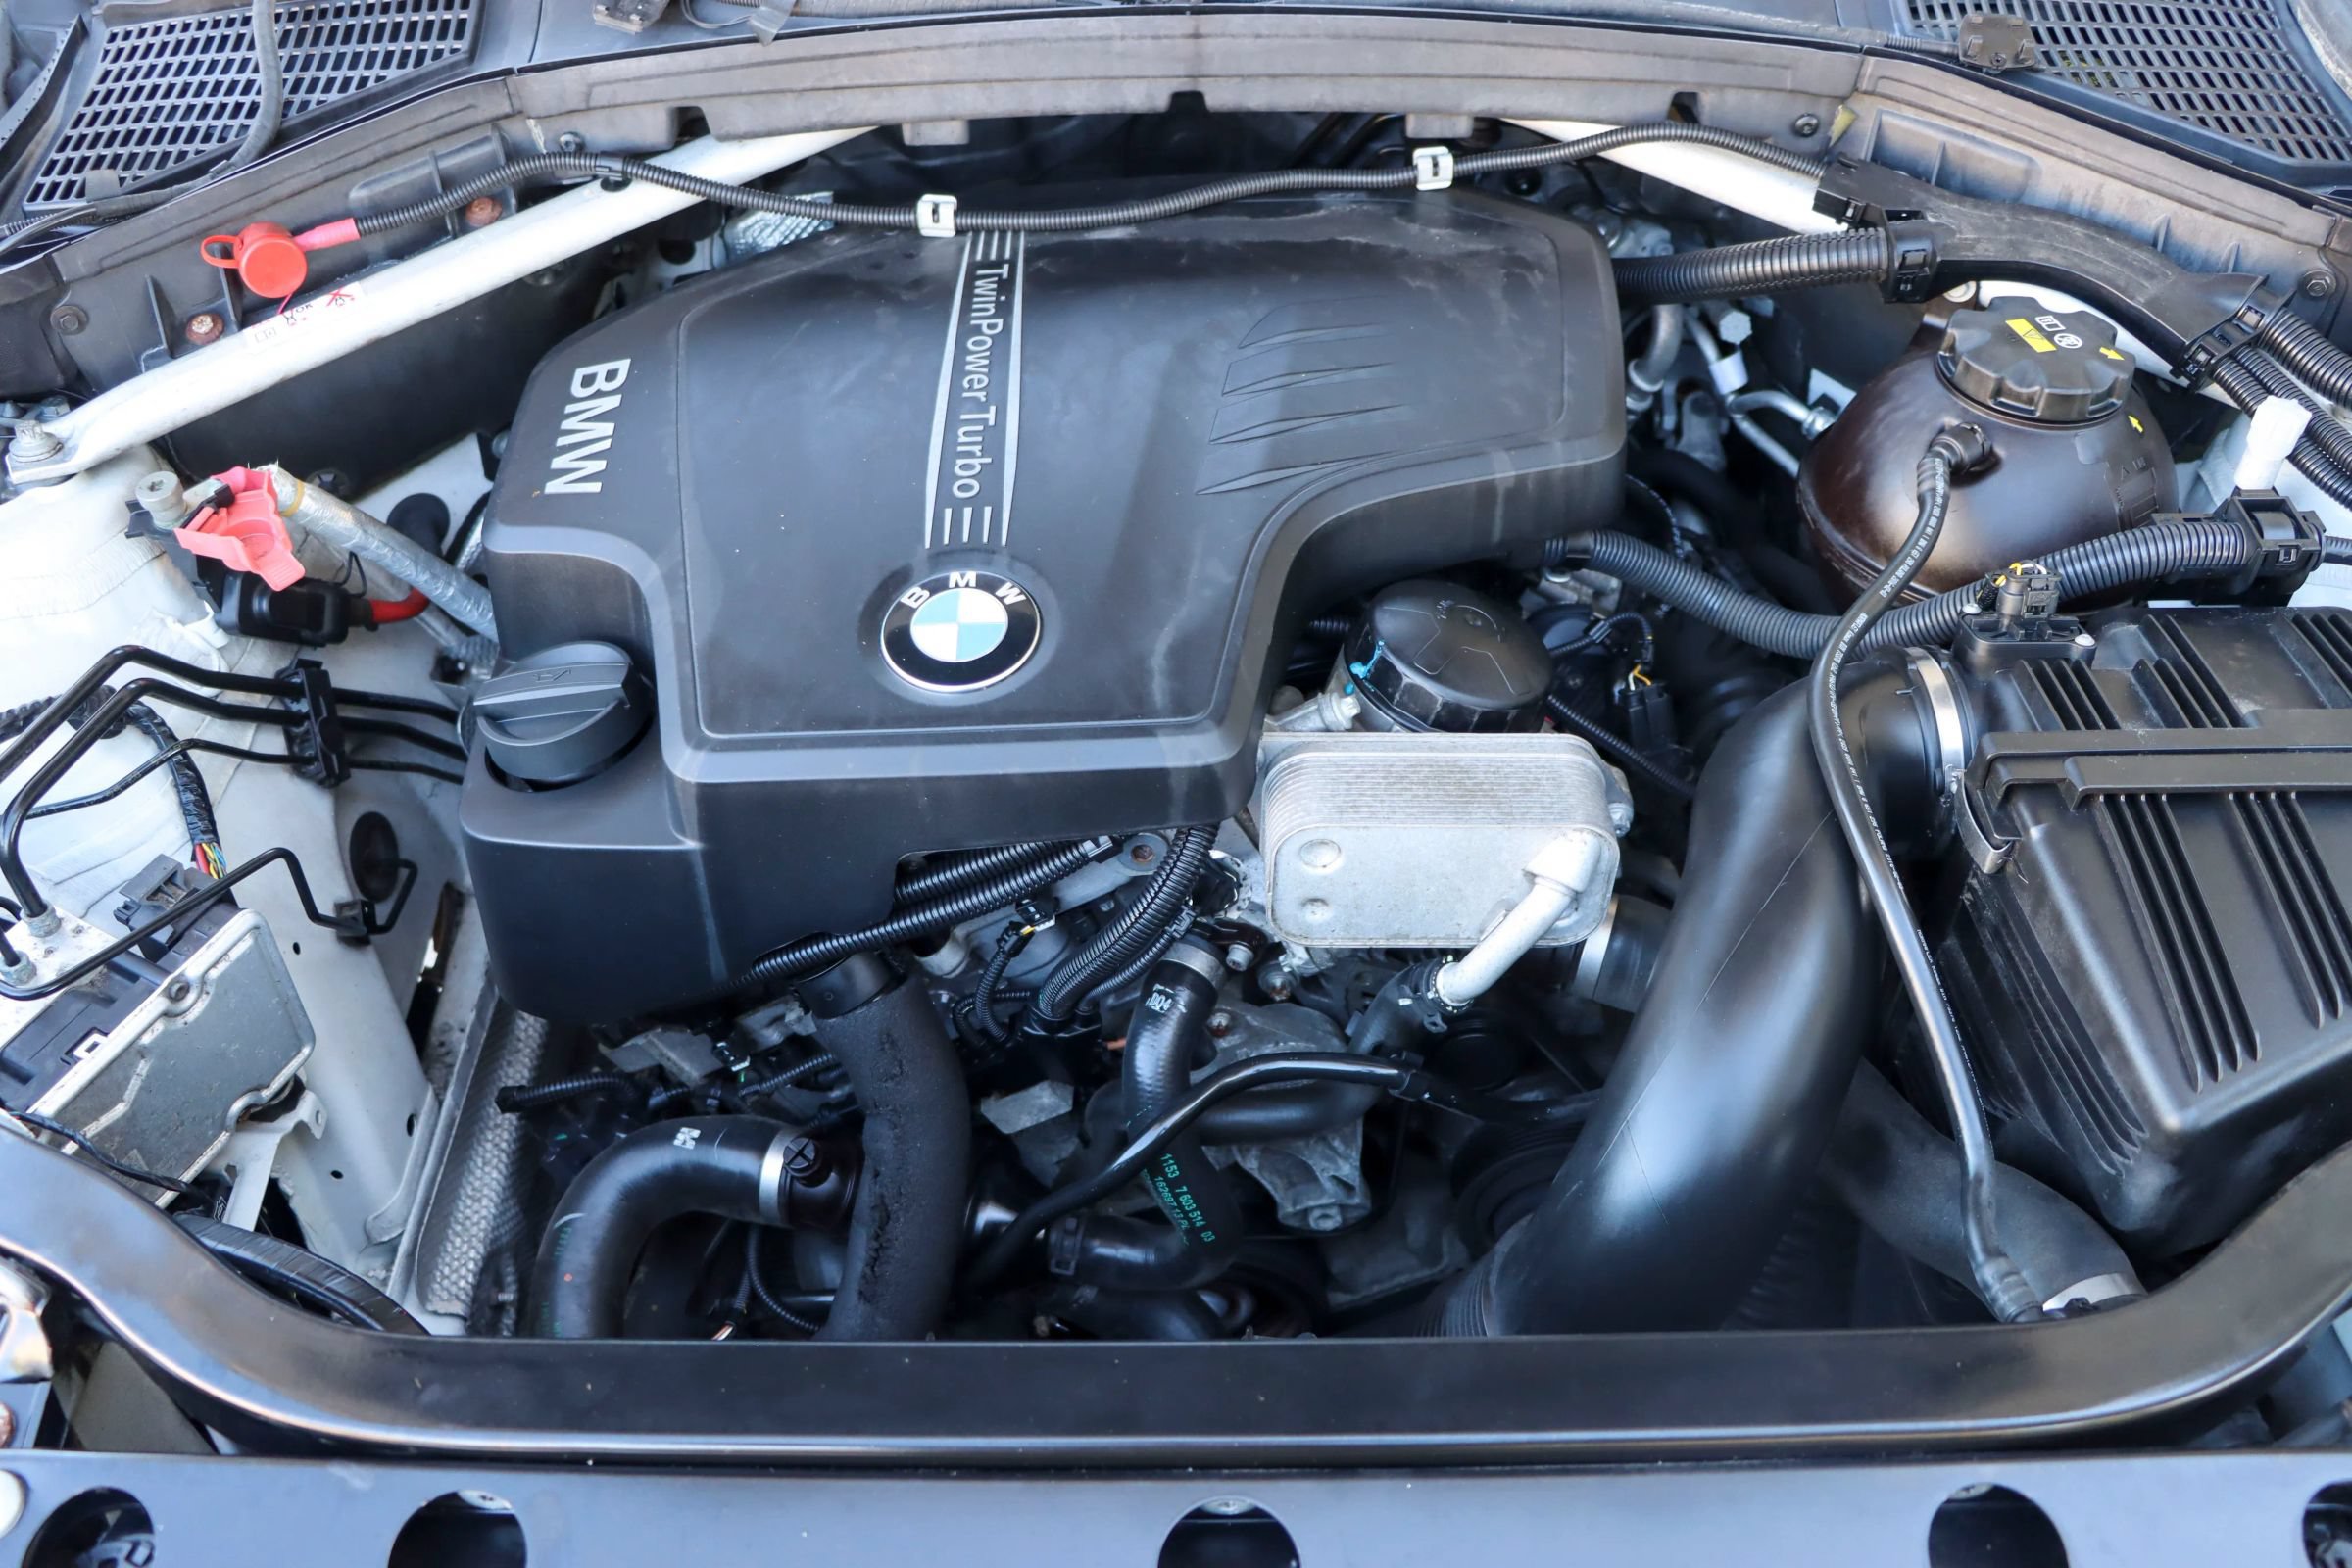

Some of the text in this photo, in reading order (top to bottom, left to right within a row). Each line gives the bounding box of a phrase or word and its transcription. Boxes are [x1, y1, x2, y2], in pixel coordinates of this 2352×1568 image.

[952, 263, 1010, 500] TwinPower Turbo
[544, 358, 632, 495] BMW
[900, 570, 1027, 610] BMW
[1160, 1153, 1180, 1178] 1153
